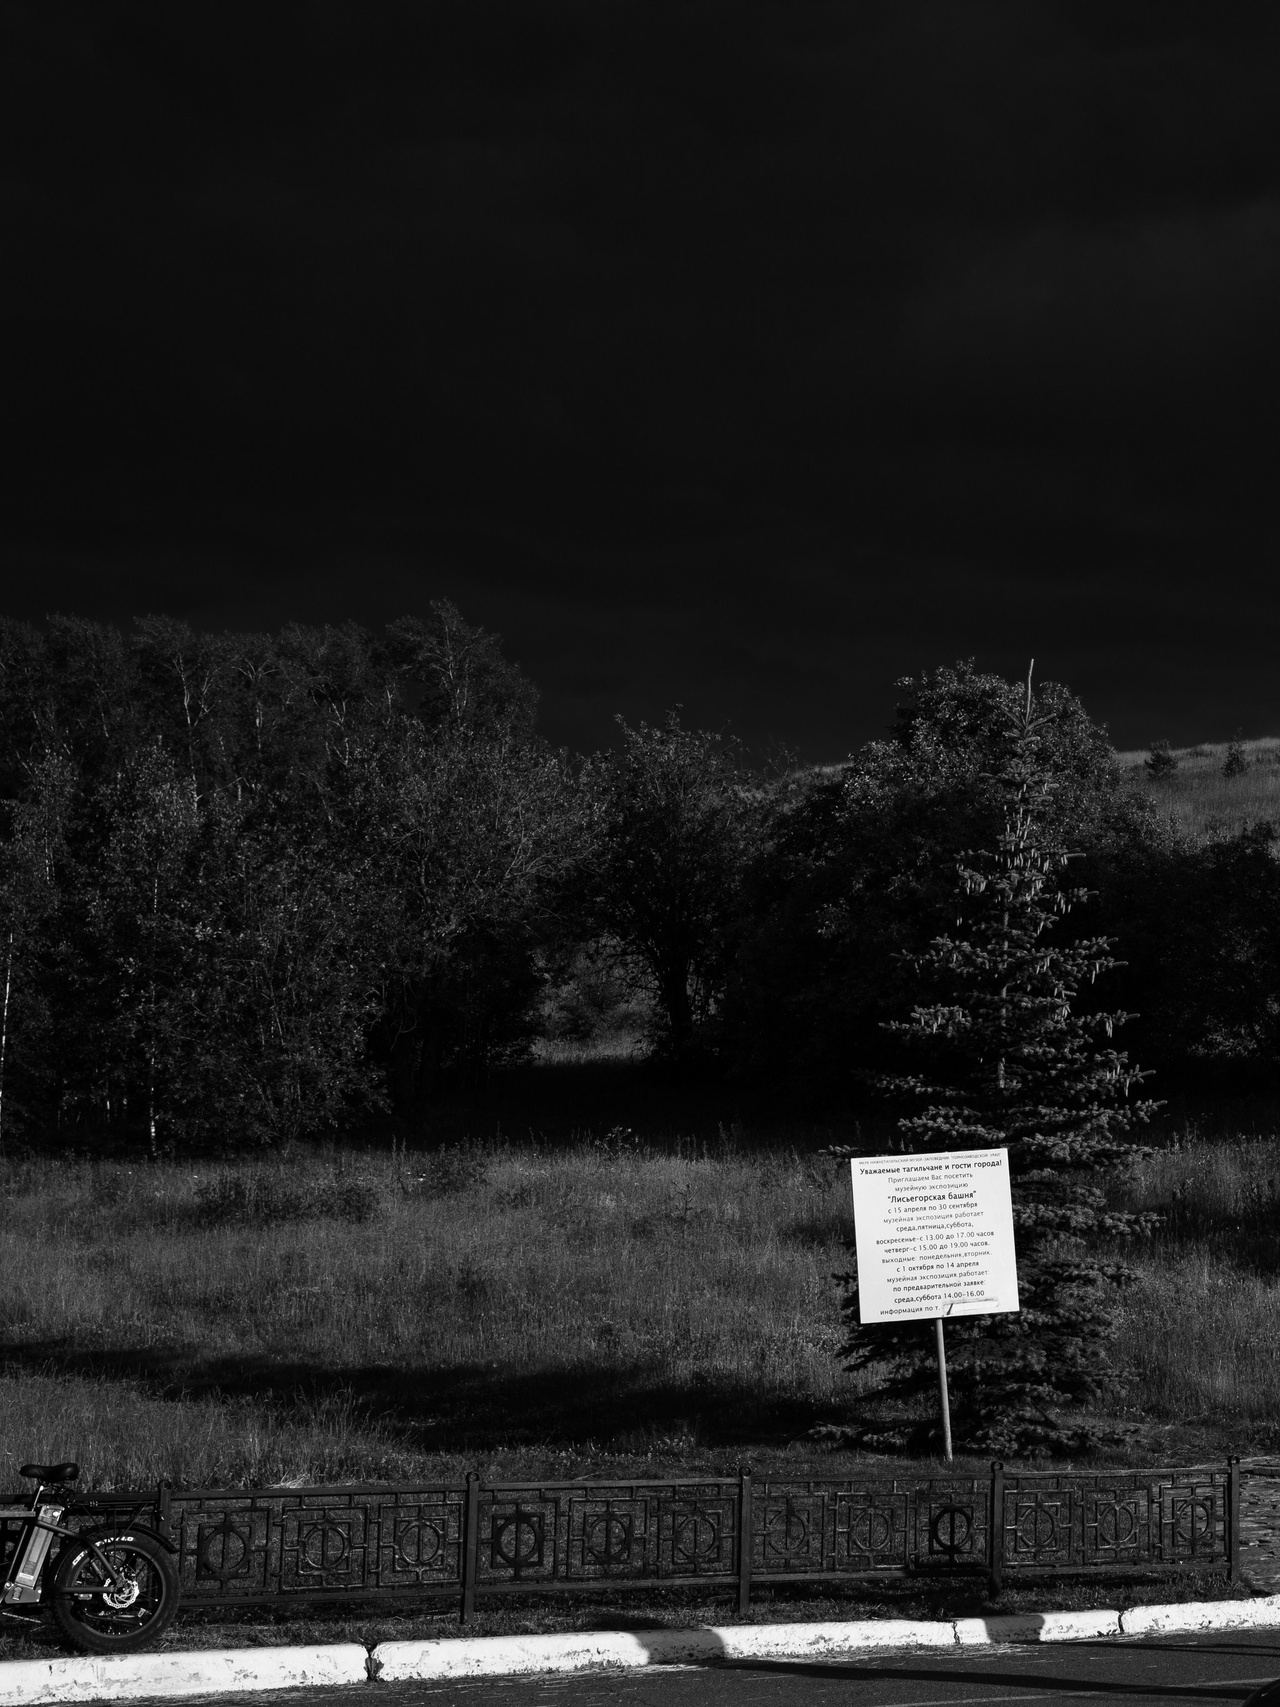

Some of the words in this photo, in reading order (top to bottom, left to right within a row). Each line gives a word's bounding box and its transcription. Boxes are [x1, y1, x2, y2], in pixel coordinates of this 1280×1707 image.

[859, 1167, 900, 1175] Уважаемые
[973, 1159, 1002, 1168] города!
[929, 1182, 968, 1190] экспозицию
[887, 1194, 945, 1203] "Лисьегорская
[947, 1190, 976, 1200] башня"
[948, 1201, 977, 1209] сентября
[883, 1216, 913, 1224] музейная
[954, 1211, 983, 1219] работает
[919, 1243, 937, 1251] 15.00
[886, 1275, 917, 1283] музейная
[903, 1281, 961, 1292] предварительной
[944, 1289, 984, 1298] 14.00-16.00
[880, 1307, 923, 1315] информация
